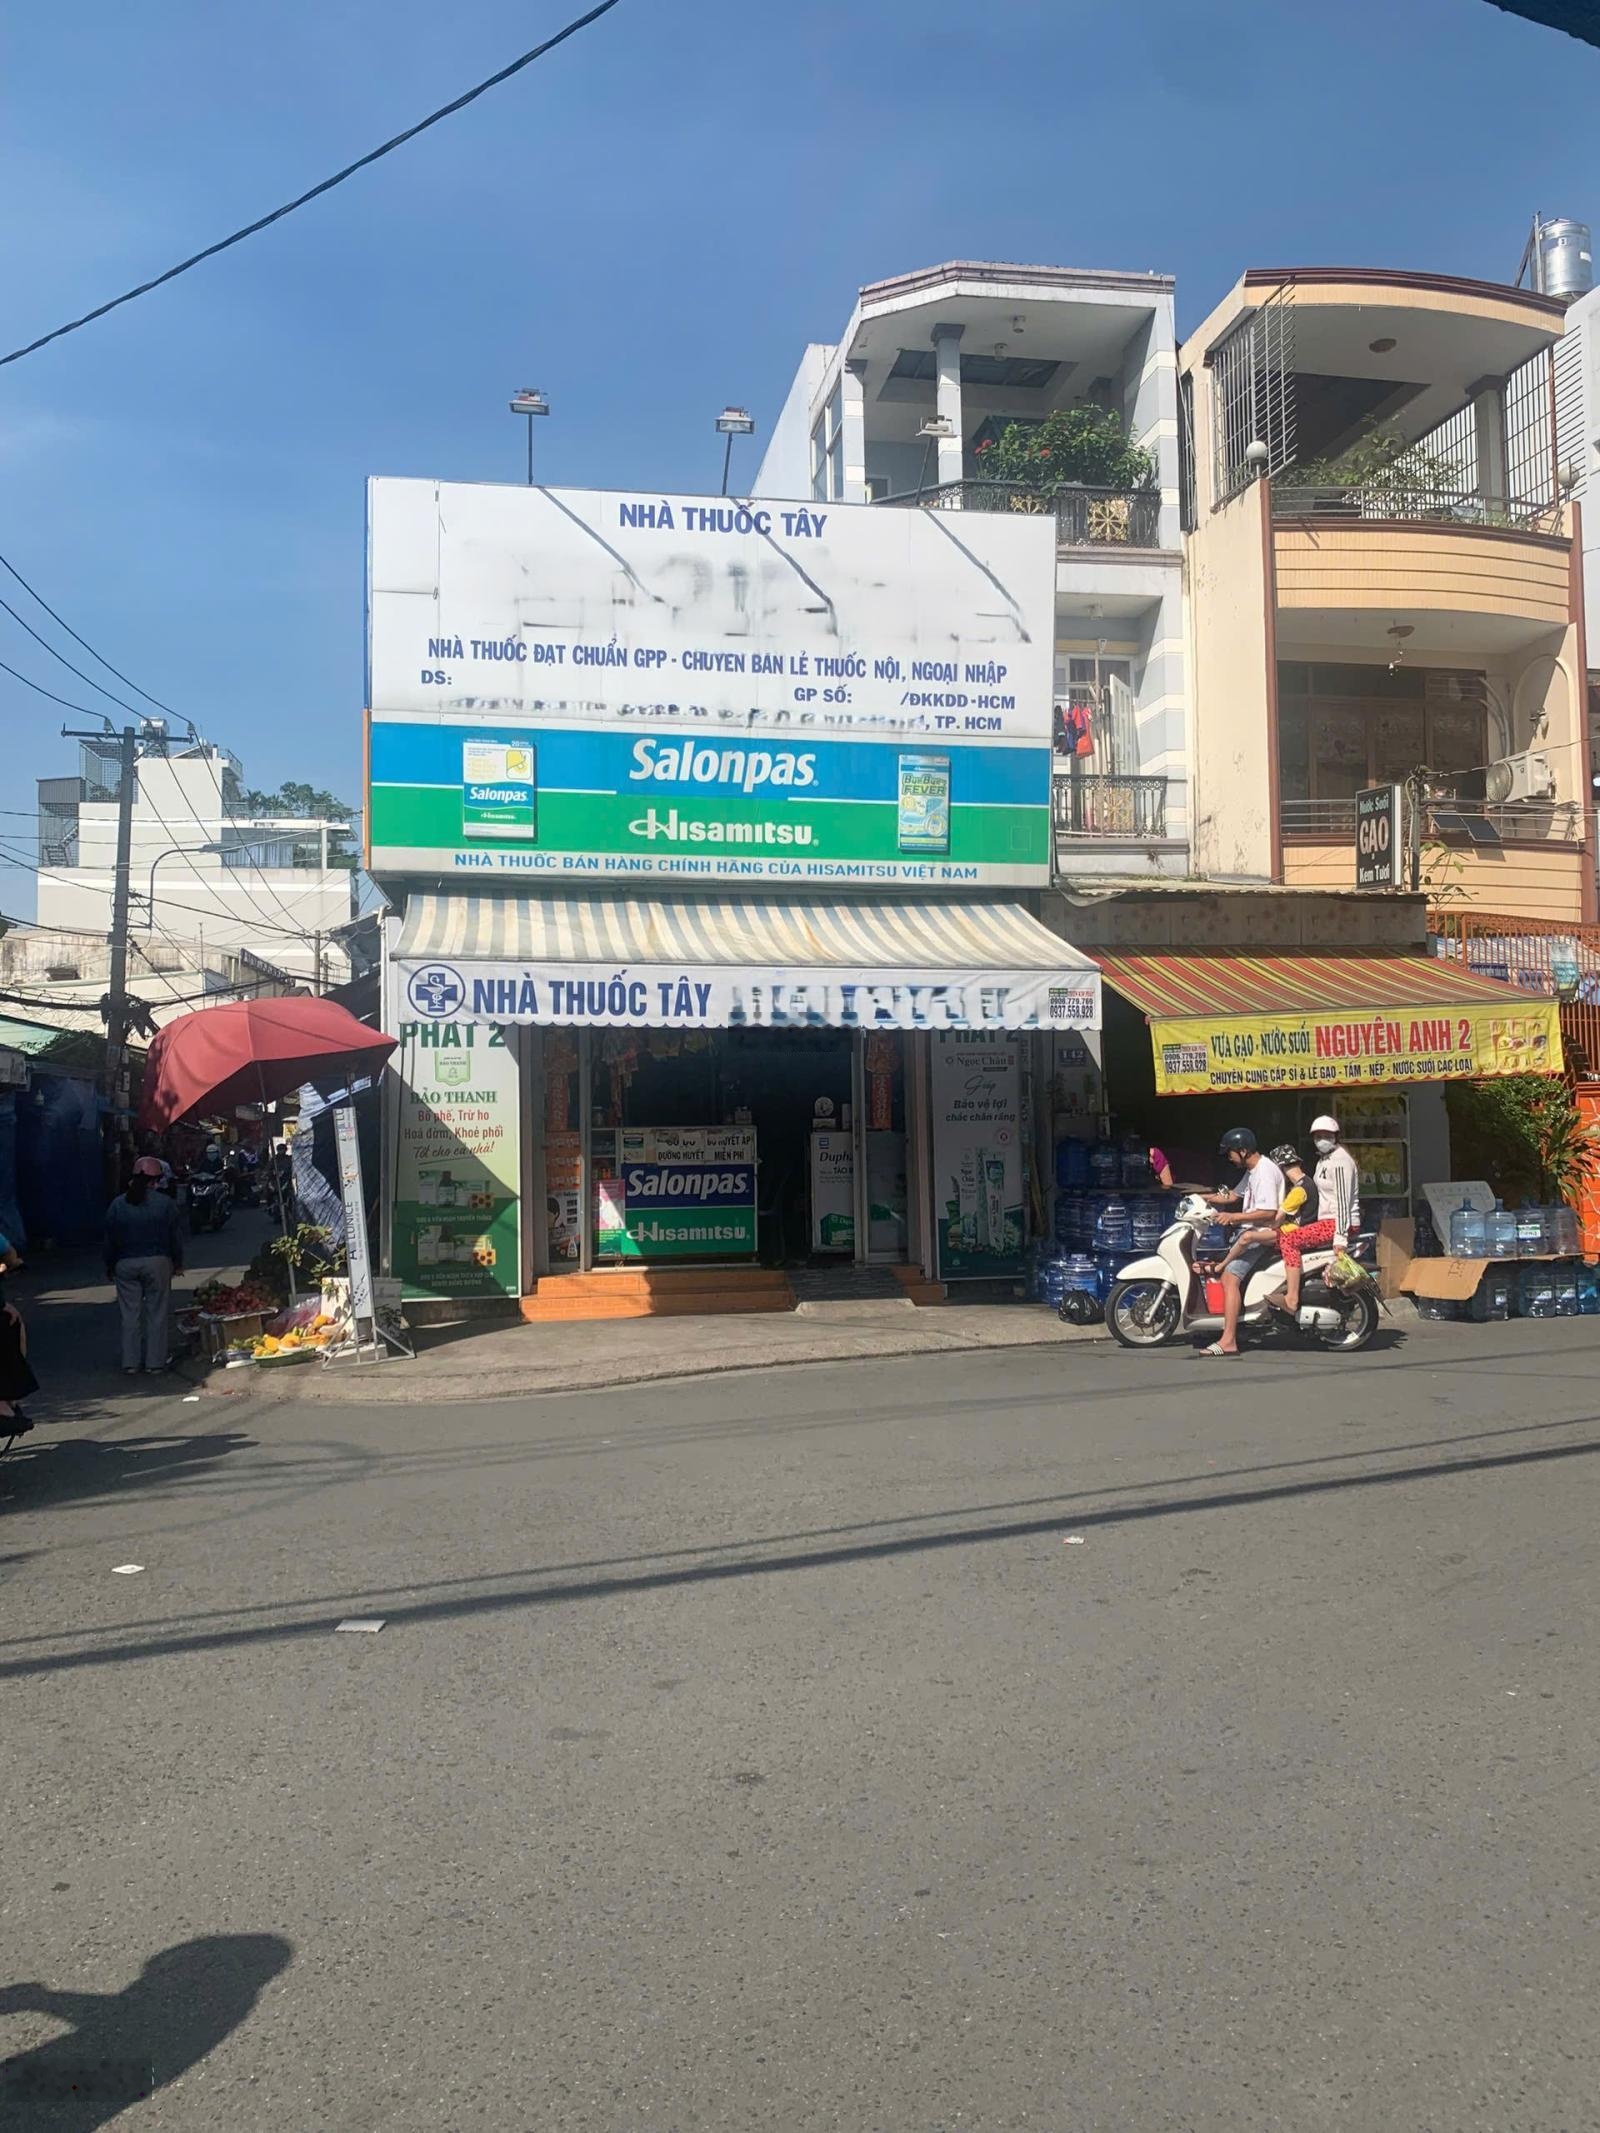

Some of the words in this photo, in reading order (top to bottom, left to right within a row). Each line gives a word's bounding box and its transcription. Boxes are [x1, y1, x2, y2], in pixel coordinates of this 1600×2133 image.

[619, 500, 674, 530] NHÀ
[682, 502, 771, 535] THUỐC
[781, 507, 828, 538] TÂY
[428, 634, 464, 660] NHÀ
[470, 635, 527, 662] THUỐC
[534, 643, 566, 667] ĐẠT
[573, 637, 627, 667] CHUẨN
[634, 648, 667, 669] GPP
[790, 651, 808, 676] LẺ
[814, 651, 866, 678] THUỐC
[874, 656, 906, 682] NỘI,
[912, 662, 958, 686] NGOẠI
[965, 660, 1007, 687] NHẬP
[421, 670, 452, 685] DS:
[794, 687, 818, 702] GP
[823, 684, 852, 703] SỐ:
[935, 716, 960, 730] TP.
[965, 716, 1002, 731] HCM
[628, 738, 817, 793] Salonpas
[469, 786, 528, 804] Salonpas
[902, 784, 947, 796] FEVER
[628, 809, 813, 846] Hisamitsu
[1360, 816, 1389, 860] GẠO
[455, 852, 492, 867] NHÀ
[500, 852, 556, 869] THUỐC
[563, 855, 599, 869] BÁN
[605, 856, 652, 871] HÀNG
[658, 857, 711, 873] CHÍNH
[717, 859, 763, 874] HÃNG
[769, 860, 801, 875] CỦA
[807, 863, 897, 877] HISAMITSU
[903, 864, 935, 881] VIỆT
[942, 866, 978, 879] NAM
[1360, 867, 1374, 882] Kem
[473, 972, 538, 1014] NHÀ
[548, 969, 647, 1017] THUỐC
[657, 975, 712, 1017] TÂY
[489, 1023, 507, 1048] 2
[1234, 1034, 1254, 1063] GẠO
[1260, 1026, 1287, 1055] NƯỚC
[1289, 1021, 1311, 1054] SUỐI
[1315, 1016, 1402, 1059] NGUYÊN
[1408, 1019, 1452, 1053] ANH
[1457, 1019, 1471, 1051] 2
[1246, 1069, 1268, 1083] CUNG
[1300, 1068, 1306, 1080] &
[1320, 1065, 1337, 1082] GẠO
[444, 1090, 497, 1104] THANH
[477, 1109, 490, 1121] ho
[819, 1151, 853, 1165] Duph
[627, 1168, 748, 1200] Salonpas
[626, 1221, 746, 1242] Hisamitsu
